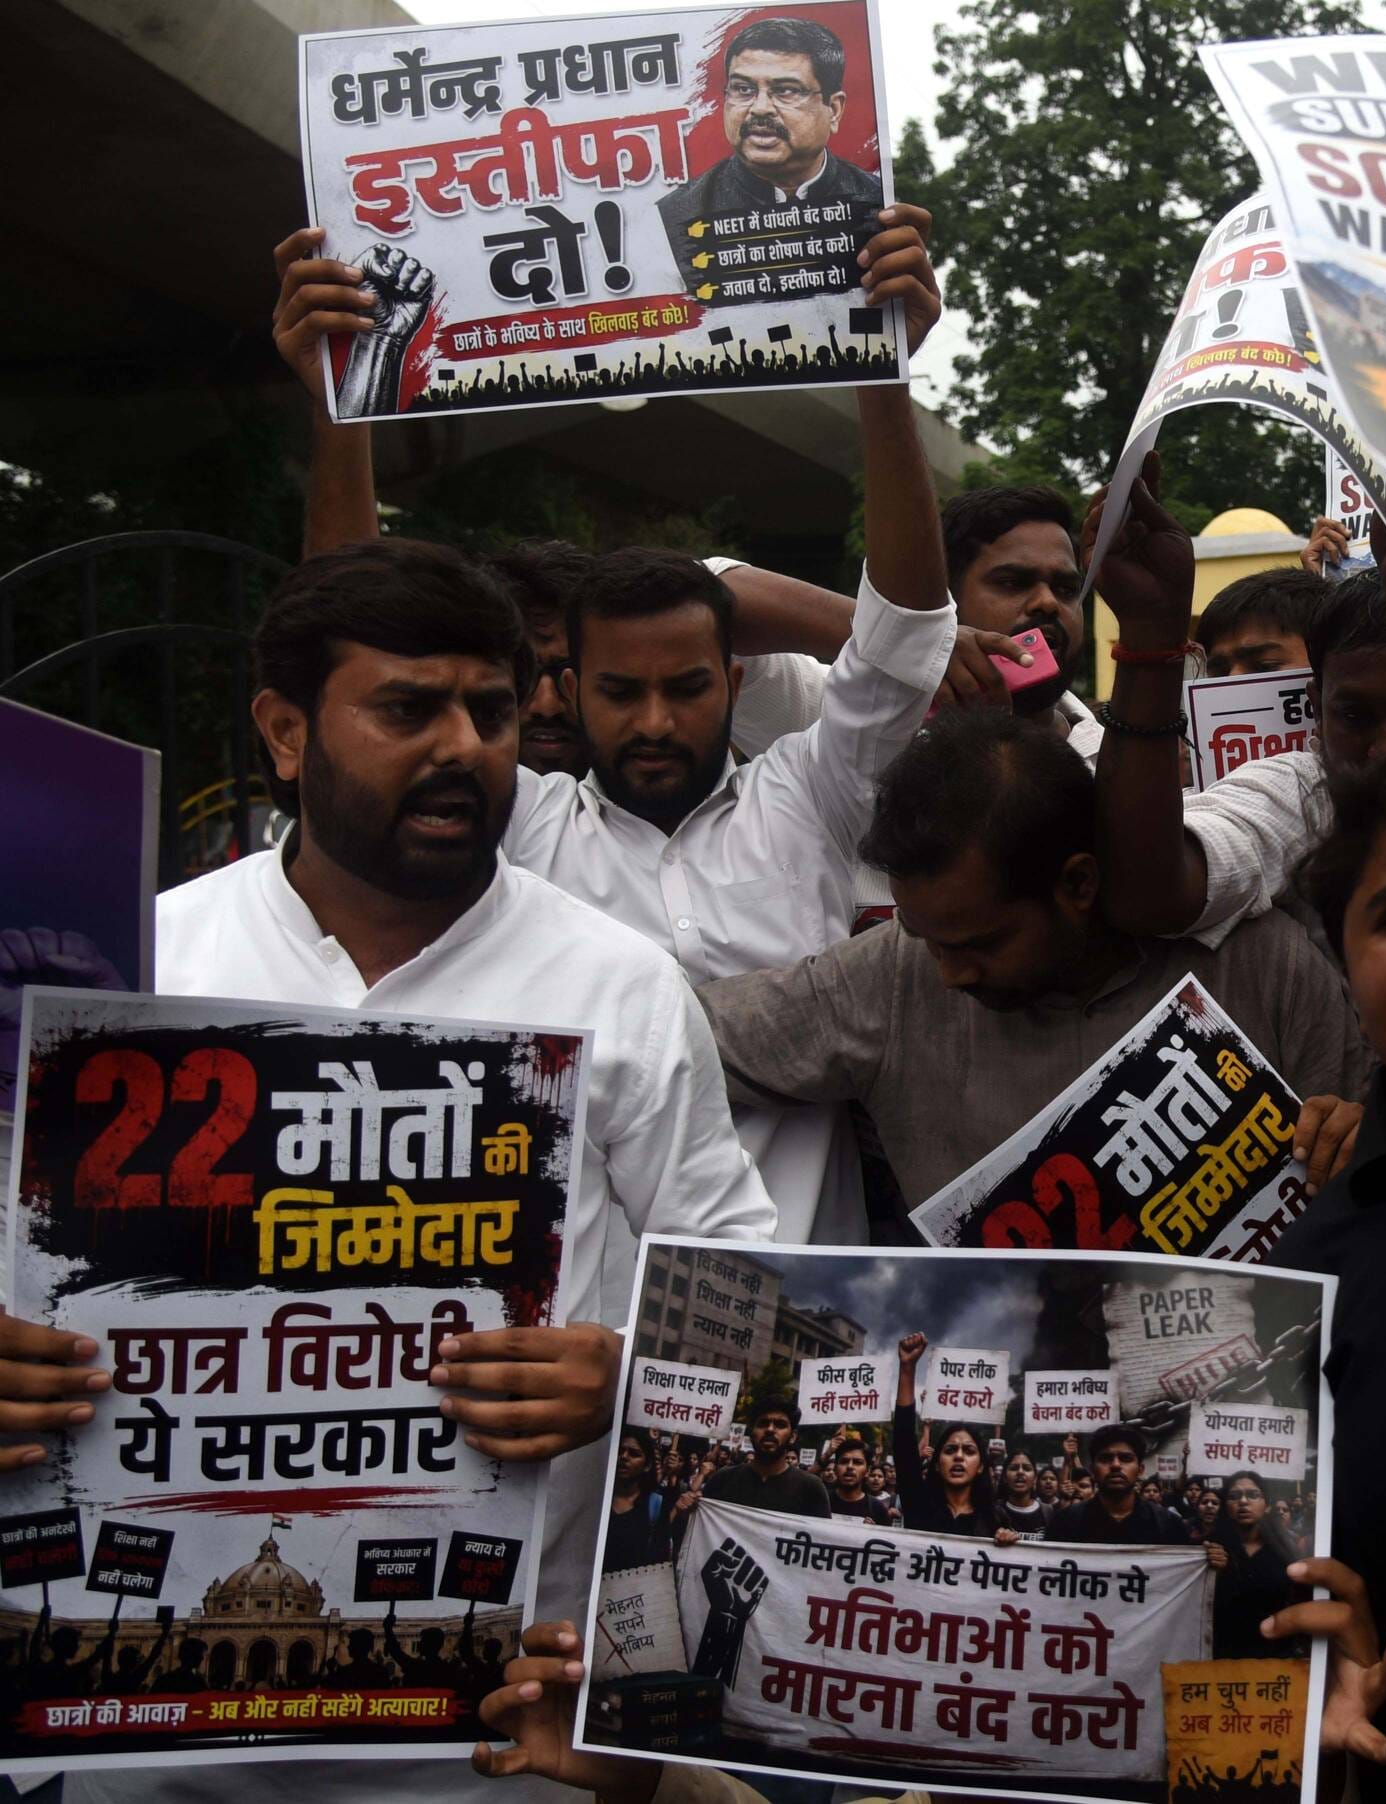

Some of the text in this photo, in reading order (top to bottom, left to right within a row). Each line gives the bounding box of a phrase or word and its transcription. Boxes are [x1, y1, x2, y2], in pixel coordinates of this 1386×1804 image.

[331, 33, 681, 121] धर्मेन्द्र प्रधान
[346, 107, 690, 233] इस्तीफा
[714, 217, 744, 235] NEET
[748, 211, 761, 230] में
[764, 207, 800, 229] धांधली
[803, 205, 819, 225] बंद
[718, 245, 746, 266] छात्रों
[749, 246, 765, 263] का
[768, 240, 803, 260] शोषण
[805, 236, 823, 256] बंद
[722, 279, 755, 297] जवाब
[779, 269, 825, 292] इस्तीफा
[453, 327, 482, 352] छात्रों
[484, 326, 497, 347] के
[500, 321, 540, 344] भविष्य
[542, 318, 556, 339] के
[559, 319, 586, 338] साथ
[642, 306, 659, 327] बंद
[72, 1047, 533, 1208] 22 मौतों की
[1093, 1034, 1253, 1197] मौतों की
[252, 1185, 520, 1275] जिम्मेदार
[1140, 1287, 1215, 1315] PAPER
[1144, 1312, 1214, 1339] LEAK
[107, 1300, 474, 1394] छात्र विरोधी
[643, 1366, 731, 1397] शिक्षा पर हमला
[817, 1365, 846, 1384] फीस
[940, 1358, 997, 1379] पेपर लीक
[810, 1389, 879, 1414] नहीं चलेगी
[938, 1386, 994, 1409] बंद करो
[1036, 1381, 1068, 1397] हमारा
[694, 1405, 723, 1428] नहीं
[1065, 1402, 1083, 1420] बंद
[1085, 1401, 1111, 1420] करो
[1258, 1415, 1296, 1435] हमारी
[115, 1397, 460, 1482] ये सरकार
[1247, 1445, 1291, 1464] हमारा
[376, 1562, 416, 1576] सरकार
[970, 1550, 1032, 1593] पेपर
[1038, 1559, 1112, 1601] लीक
[1117, 1565, 1149, 1604] से
[805, 1587, 1114, 1676] प्रतिभाओं को
[761, 1655, 1145, 1750] मारना बंद करो
[1180, 1675, 1291, 1708] हम चुप नहीं
[47, 1698, 93, 1727] छात्रों
[97, 1697, 122, 1725] की
[208, 1698, 239, 1721] अब
[244, 1692, 279, 1719] और
[281, 1693, 322, 1720] नहीं
[1179, 1714, 1212, 1734] अब
[1260, 1709, 1293, 1736] नहीं
